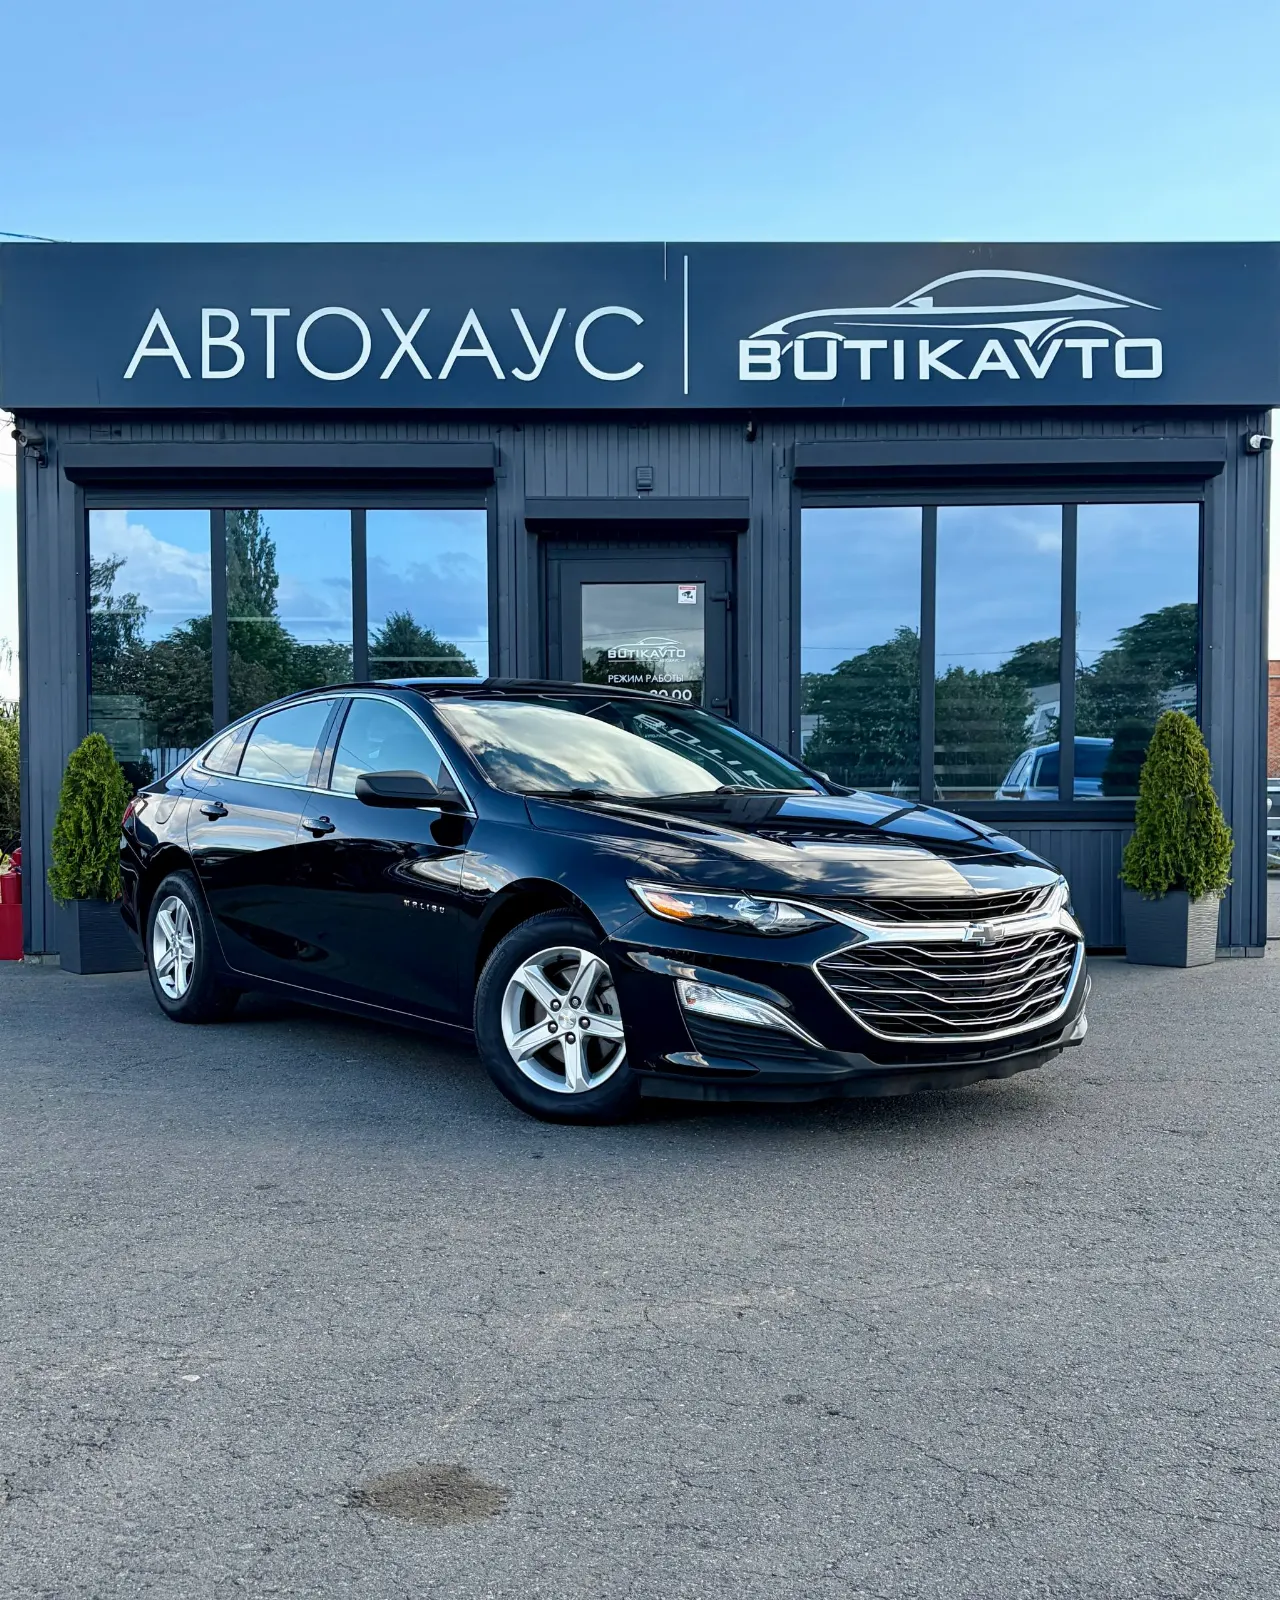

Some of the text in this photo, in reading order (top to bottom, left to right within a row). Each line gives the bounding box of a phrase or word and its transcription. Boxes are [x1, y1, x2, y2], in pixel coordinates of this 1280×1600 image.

[123, 306, 645, 381] АВТОХАУС
[738, 338, 1163, 381] BUTIKAVTO
[607, 649, 686, 659] BUTIKAVTO
[608, 674, 684, 683] РЕЖИМ РАБОТЫ
[649, 689, 692, 701] 000
[403, 899, 445, 913] MALIBU
